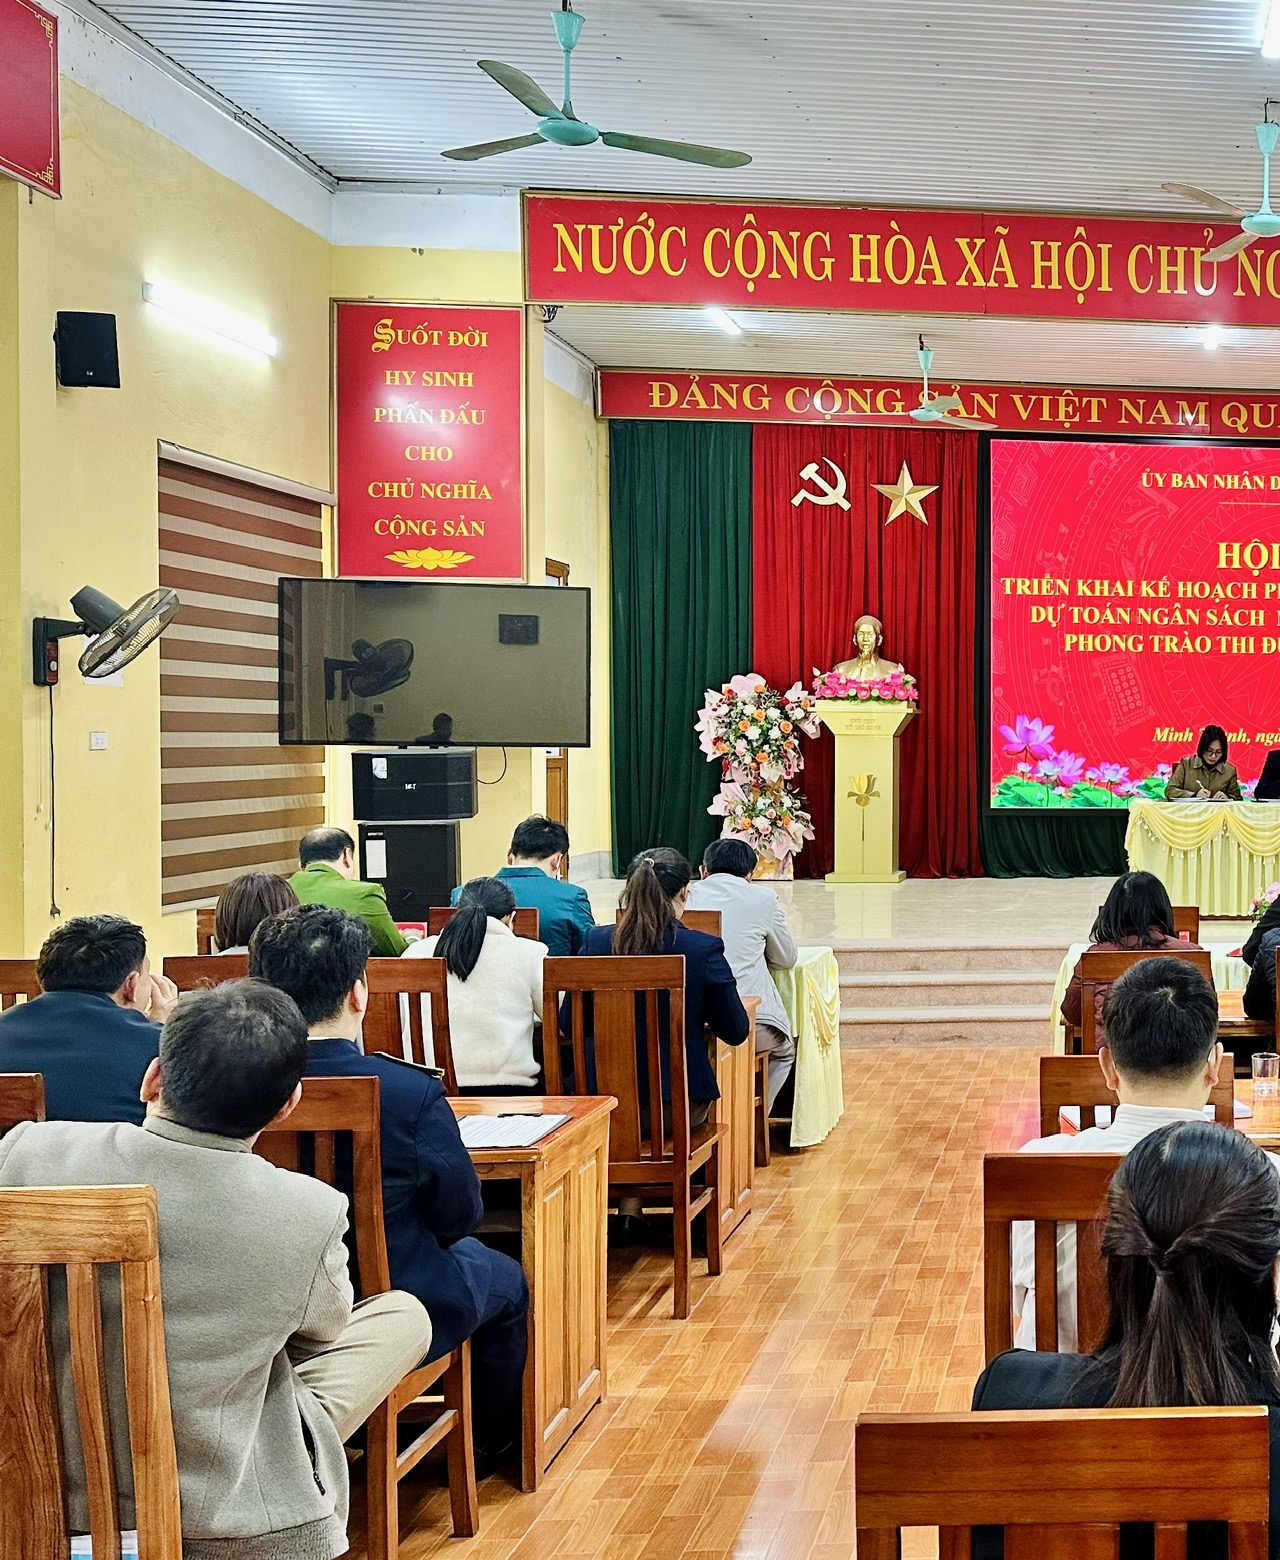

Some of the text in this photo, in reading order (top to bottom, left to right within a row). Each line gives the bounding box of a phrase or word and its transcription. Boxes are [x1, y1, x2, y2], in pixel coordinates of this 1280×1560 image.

[552, 211, 688, 277] NƯỚC
[703, 213, 835, 293] CỘNG
[849, 221, 946, 285] HÒA
[955, 226, 1019, 289] XÃ
[1030, 226, 1112, 304] HỘI
[1127, 228, 1218, 297] CHỦ
[371, 318, 488, 353] SUỐT ĐỜI
[385, 370, 474, 388] HY SINH
[373, 401, 486, 425] PHẤN ĐẤU
[648, 374, 772, 411] ĐẢNG
[785, 379, 905, 420] CỘNG
[1010, 389, 1106, 428] VIỆT
[1118, 398, 1209, 427] NAM
[404, 445, 453, 462] CHO
[367, 477, 493, 500] CHỦ NGHĨA
[1141, 467, 1167, 488] ỦY
[1171, 473, 1208, 489] BAN
[1213, 470, 1265, 490] NHÂN
[374, 514, 485, 540] CỘNG SẢN
[1077, 579, 1134, 597] KHAI
[1141, 576, 1171, 598] KẾ
[1177, 581, 1257, 603] HOẠCH
[1030, 602, 1065, 628] DỰ
[1069, 602, 1131, 625] TOÁN
[1137, 603, 1200, 626] NGÂN
[1206, 605, 1266, 627] SÁCH
[1064, 634, 1144, 653] PHONG
[1150, 631, 1212, 654] TRÀO
[1217, 636, 1255, 654] THI
[1153, 727, 1193, 743] Minh
